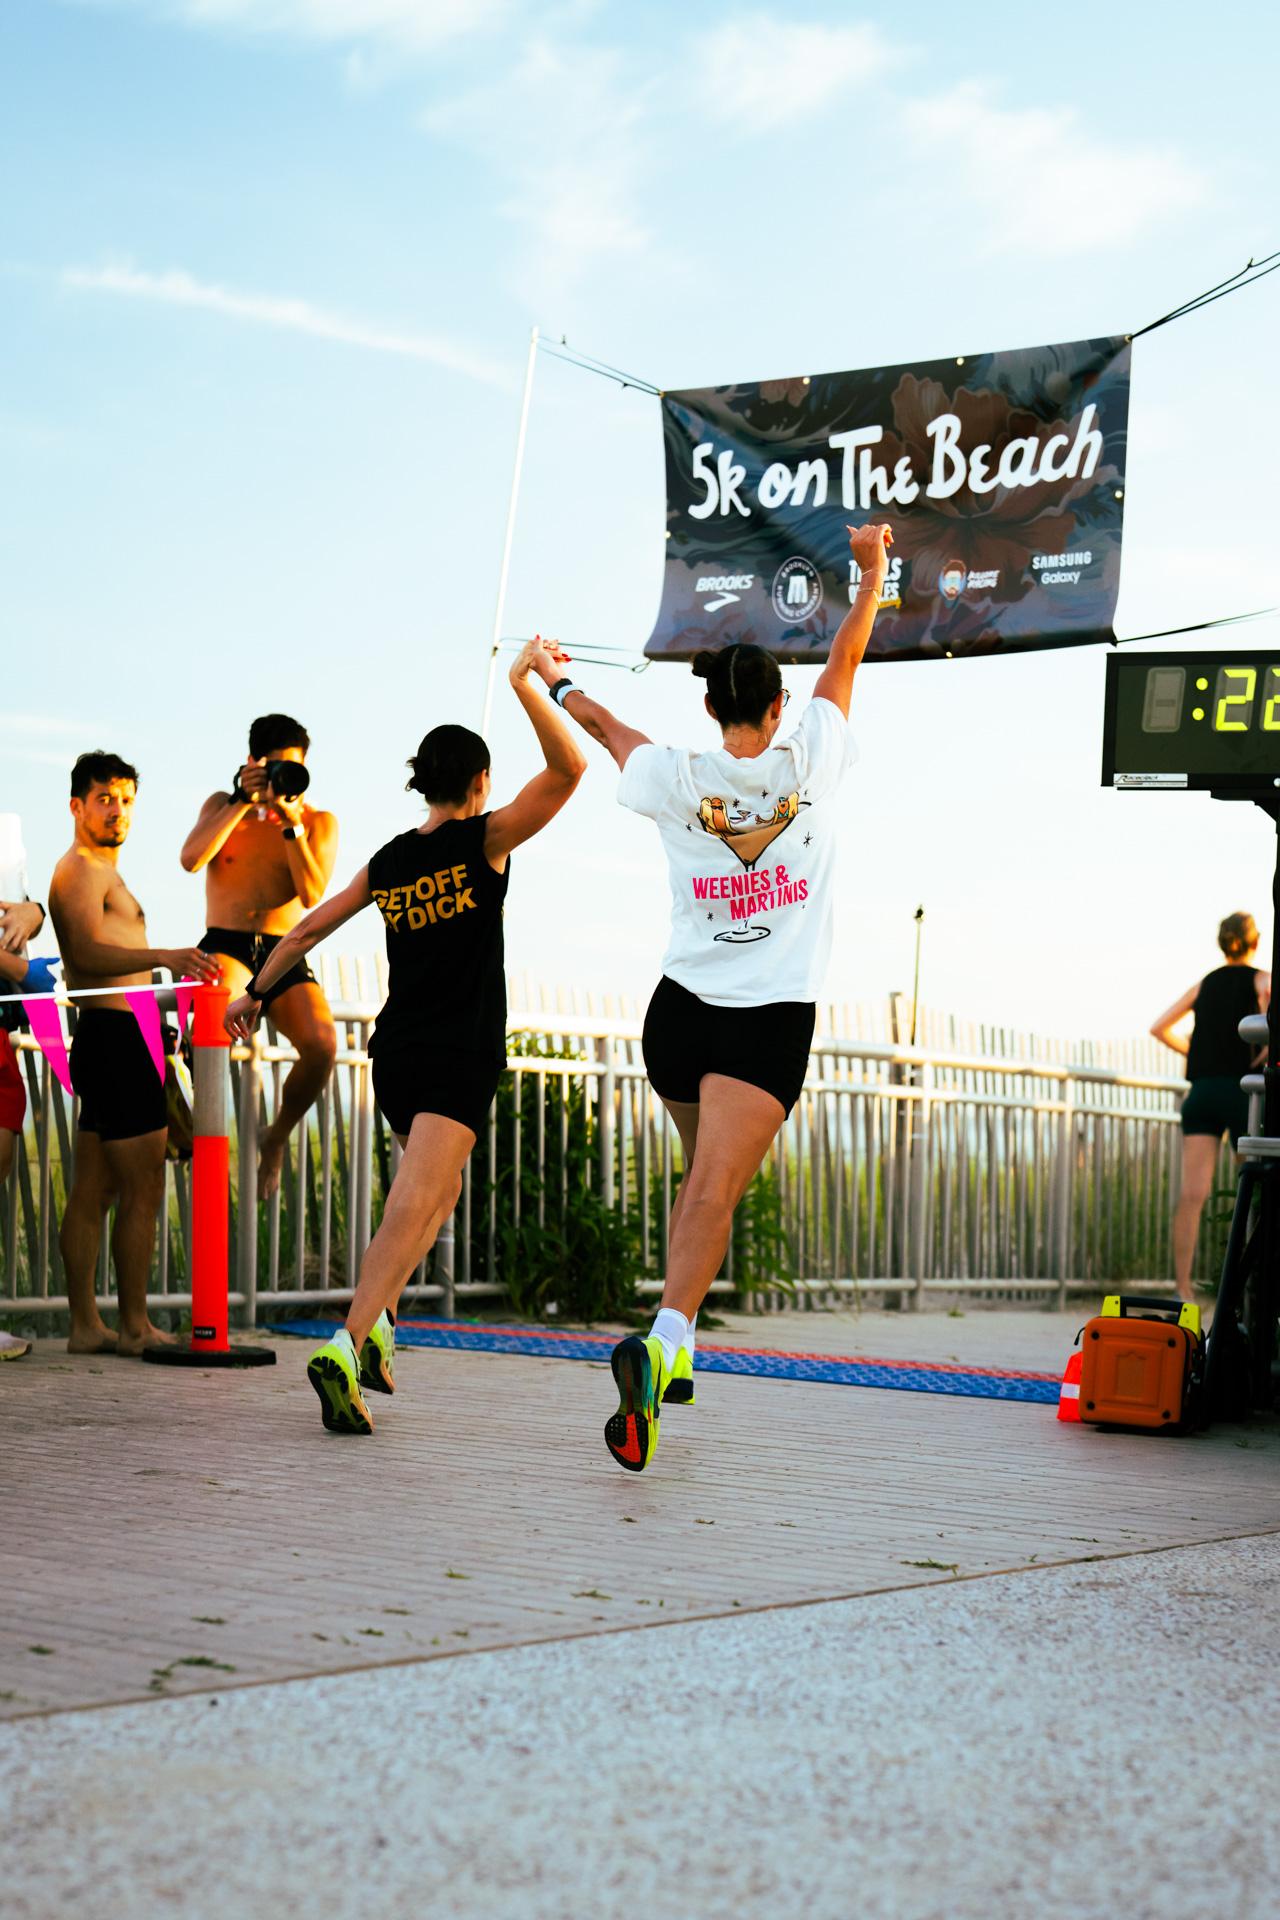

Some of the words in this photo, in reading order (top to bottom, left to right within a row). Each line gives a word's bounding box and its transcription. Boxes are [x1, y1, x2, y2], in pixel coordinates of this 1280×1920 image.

[688, 442, 751, 520] 5k
[757, 457, 828, 508] on
[828, 424, 920, 511] The
[925, 402, 1103, 500] Beach
[1032, 551, 1092, 570] SAMSUNG
[1041, 570, 1081, 585] Galaxy
[695, 574, 754, 592] BROOKS
[692, 869, 771, 900] WEENIES
[775, 864, 790, 887] &
[730, 879, 809, 921] MARTINIS
[407, 887, 478, 931] DICK
